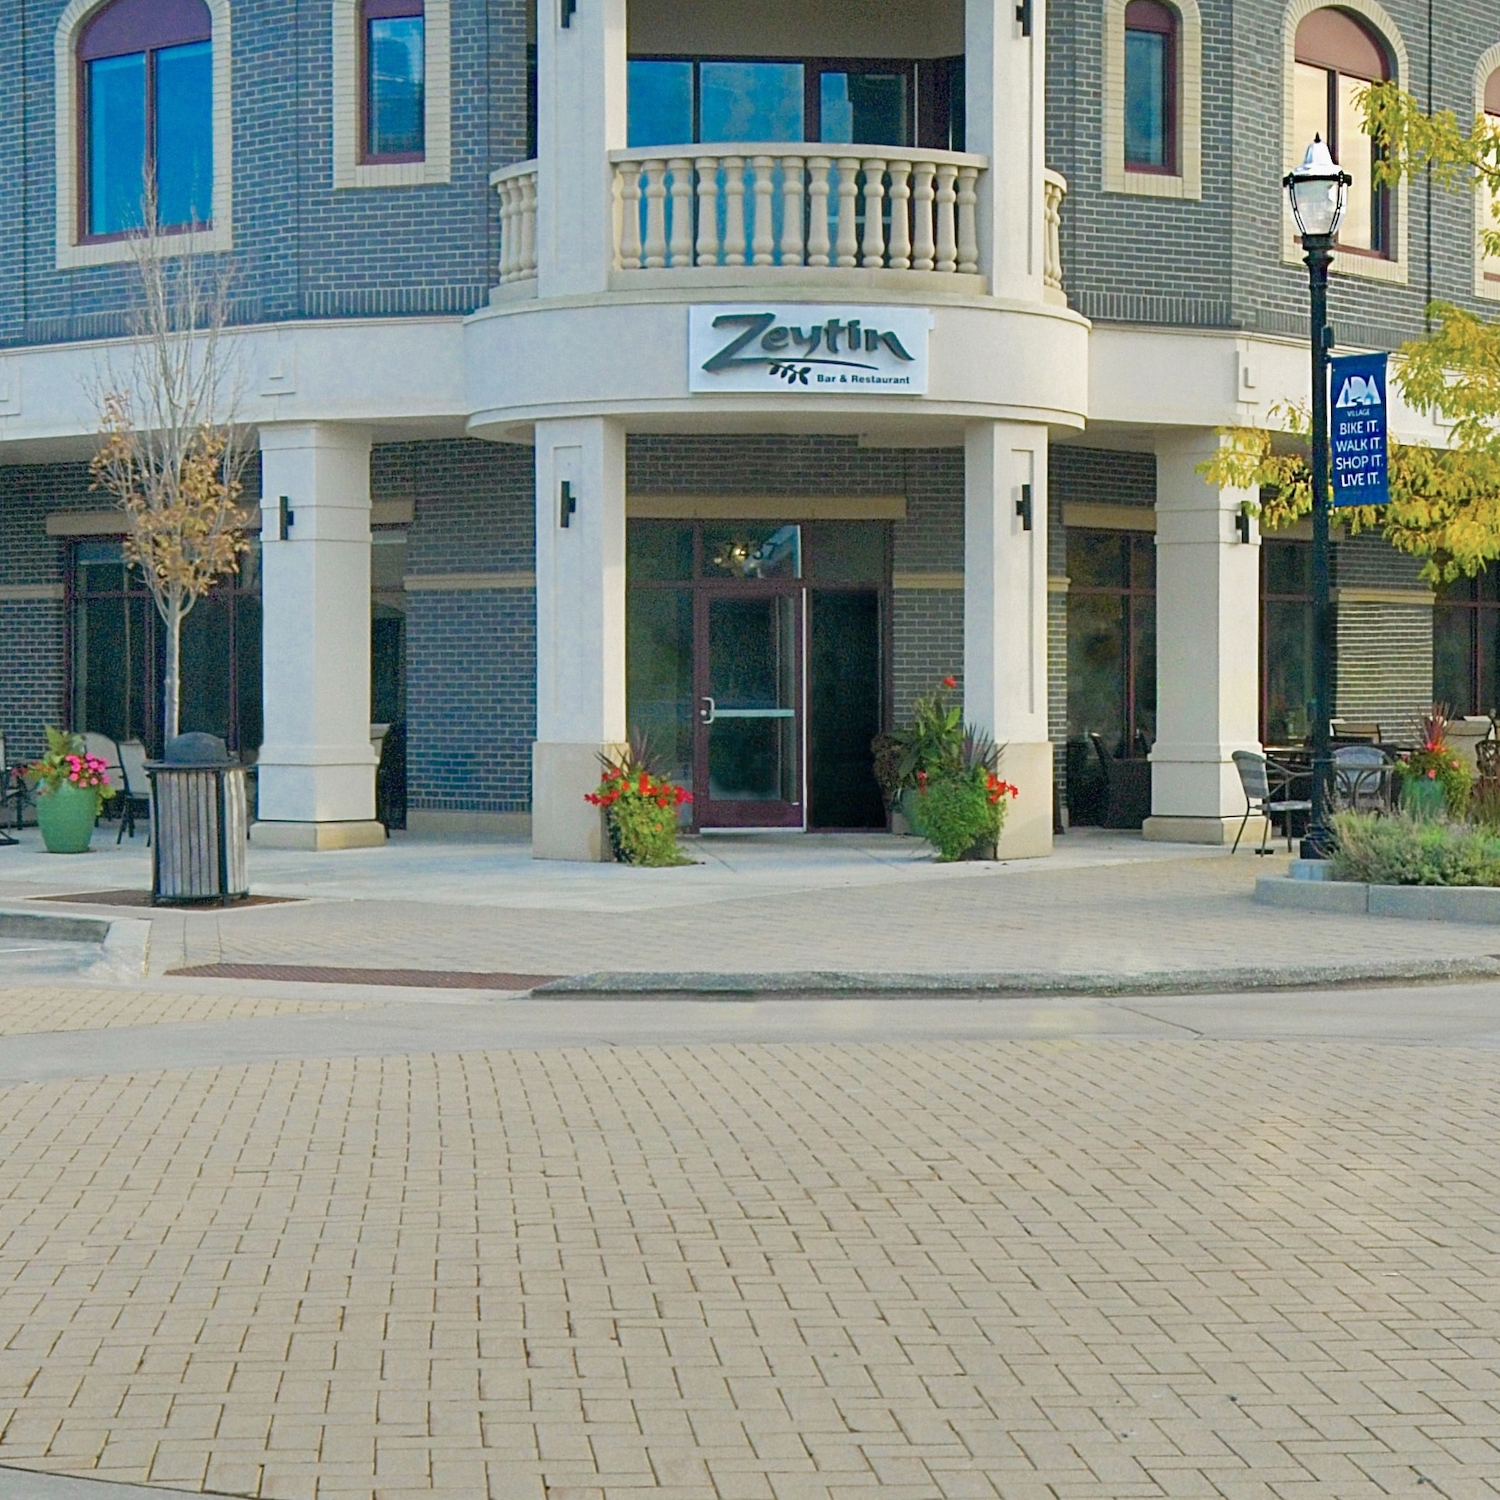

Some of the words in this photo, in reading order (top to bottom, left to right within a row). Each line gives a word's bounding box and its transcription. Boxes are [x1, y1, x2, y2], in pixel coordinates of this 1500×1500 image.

[702, 312, 915, 372] Zeytin
[817, 374, 836, 383] Bar
[840, 374, 847, 383] &
[851, 375, 910, 385] Restaurant
[1347, 408, 1370, 417] VILLAGE
[1339, 420, 1364, 436] BIKE
[1366, 419, 1379, 433] IT.
[1336, 438, 1368, 453] WALK
[1370, 436, 1382, 450] IT.
[1335, 455, 1369, 470] SHOP
[1371, 454, 1384, 467] IT.
[1341, 472, 1365, 488] LIVE
[1367, 471, 1380, 485] IT.
